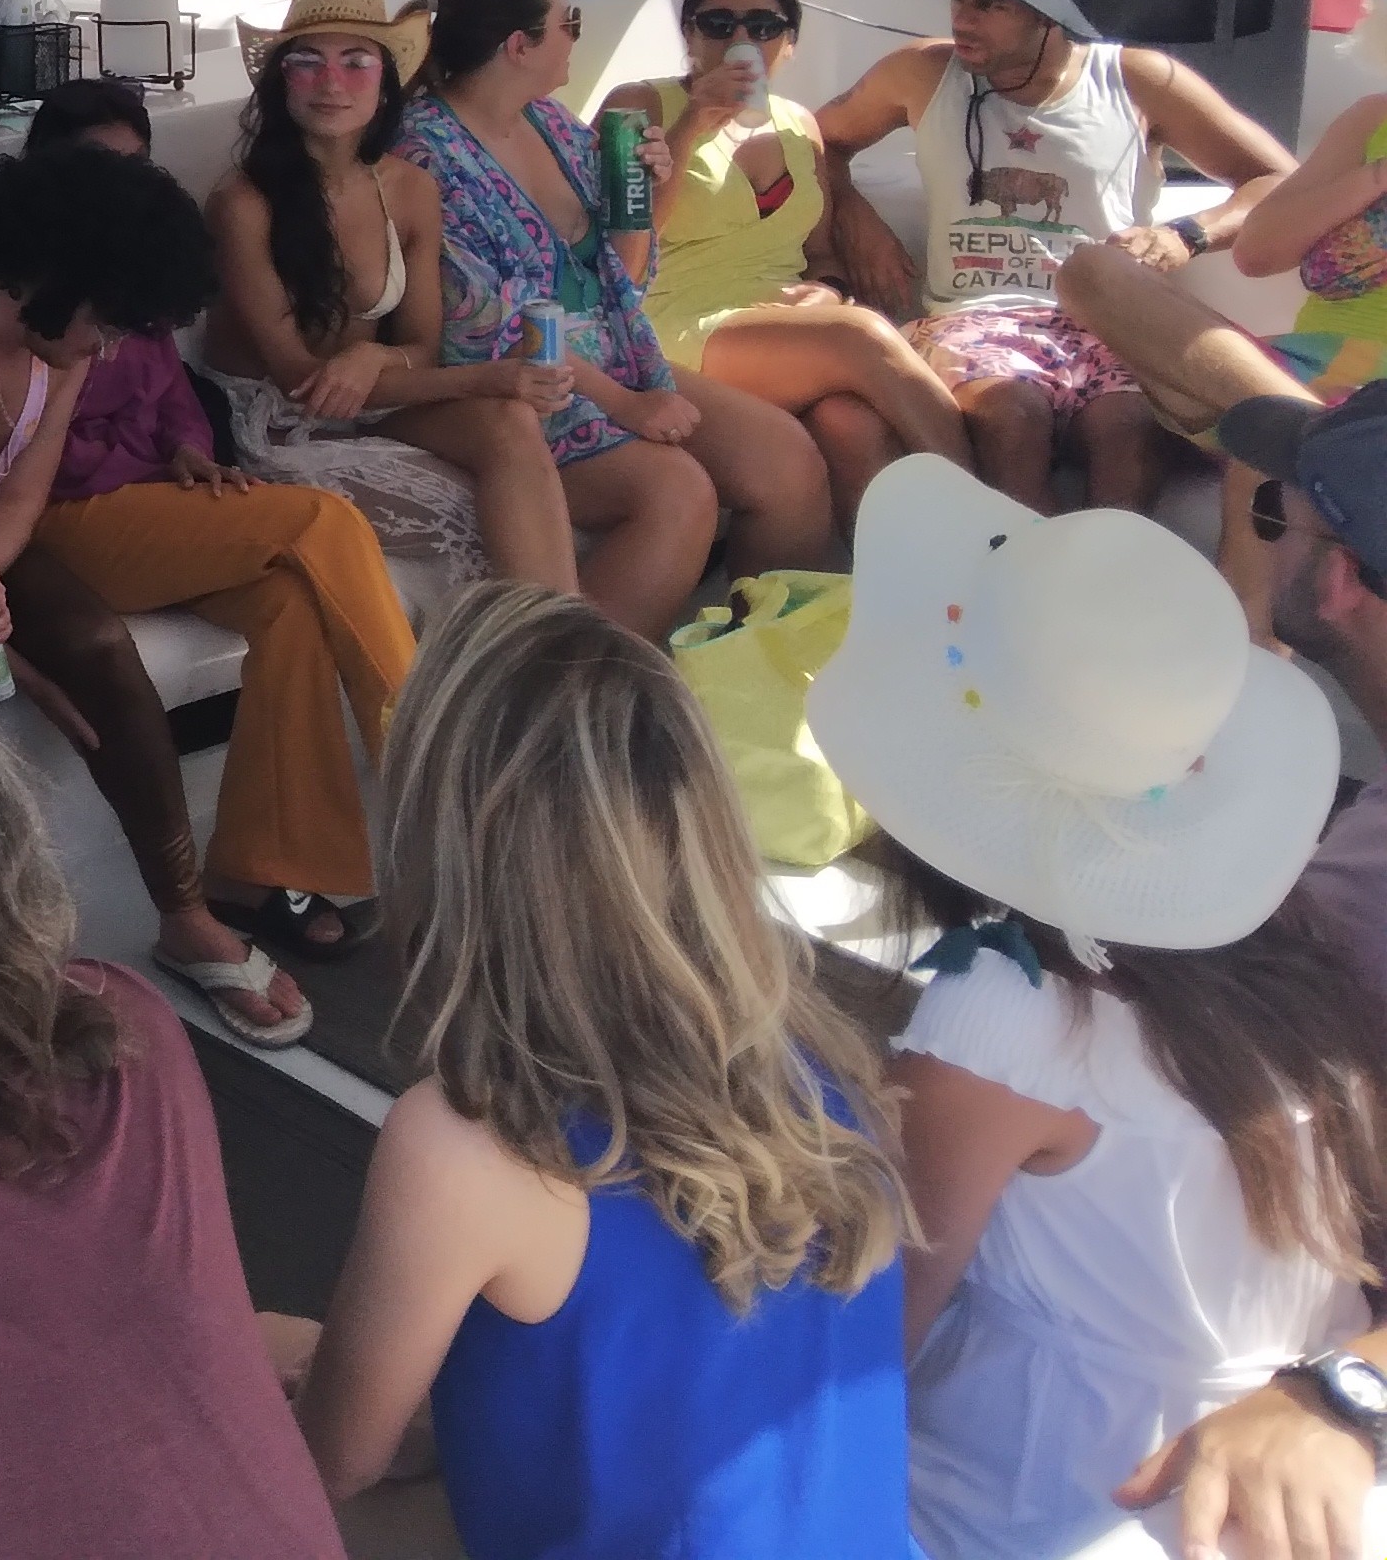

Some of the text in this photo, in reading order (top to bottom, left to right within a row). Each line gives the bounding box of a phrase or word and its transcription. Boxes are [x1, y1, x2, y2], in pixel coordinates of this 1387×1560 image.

[626, 143, 646, 216] TRU
[948, 232, 1075, 257] REPUBLI
[1007, 256, 1037, 270] OF
[951, 270, 1053, 291] CATALI
